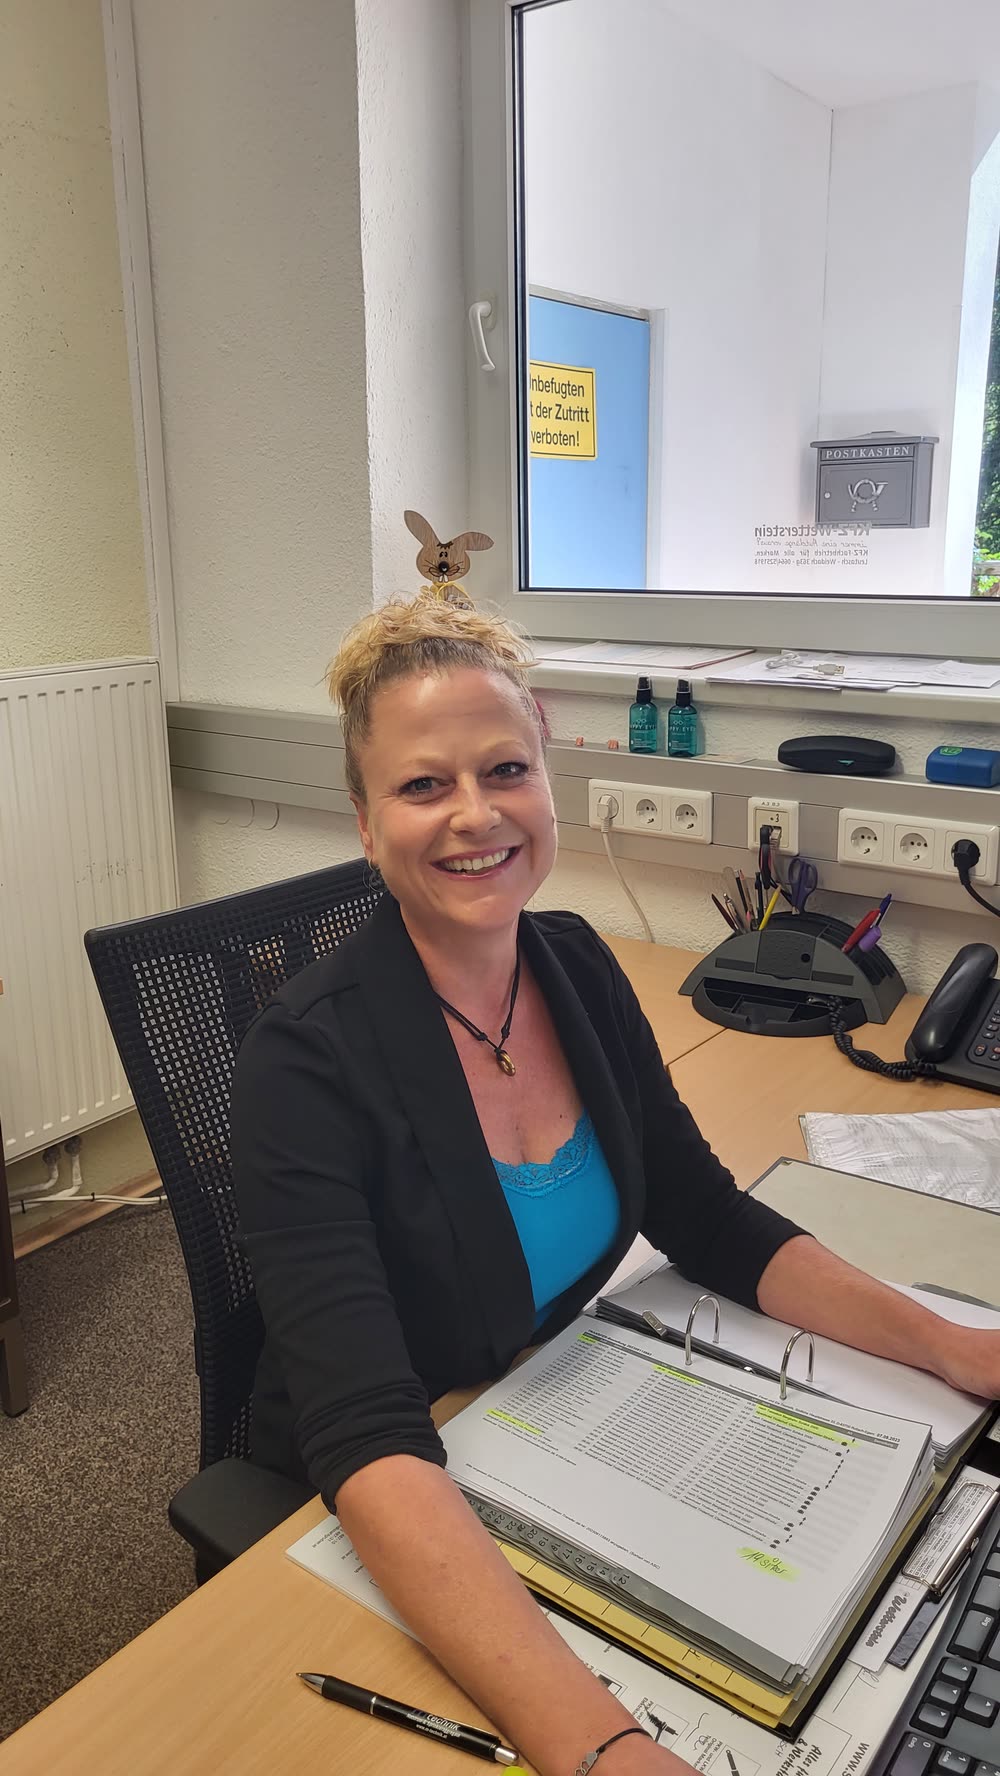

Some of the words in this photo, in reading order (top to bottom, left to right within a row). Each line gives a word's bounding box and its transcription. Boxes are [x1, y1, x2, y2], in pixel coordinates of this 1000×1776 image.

[535, 403, 552, 419] der
[555, 403, 590, 423] Zutritt
[531, 428, 580, 447] verboten!
[826, 446, 910, 458] POSTKASTEN
[494, 1514, 505, 1524] 23
[505, 1520, 517, 1531] 22
[526, 1528, 538, 1540] 20
[538, 1536, 549, 1547] 19
[562, 1548, 573, 1560] 17
[574, 1554, 586, 1565] 16
[586, 1561, 598, 1572] 15
[598, 1566, 610, 1577] 14
[618, 1575, 630, 1585] 12
[981, 1616, 991, 1627] Strg
[802, 1744, 822, 1768] Alles
